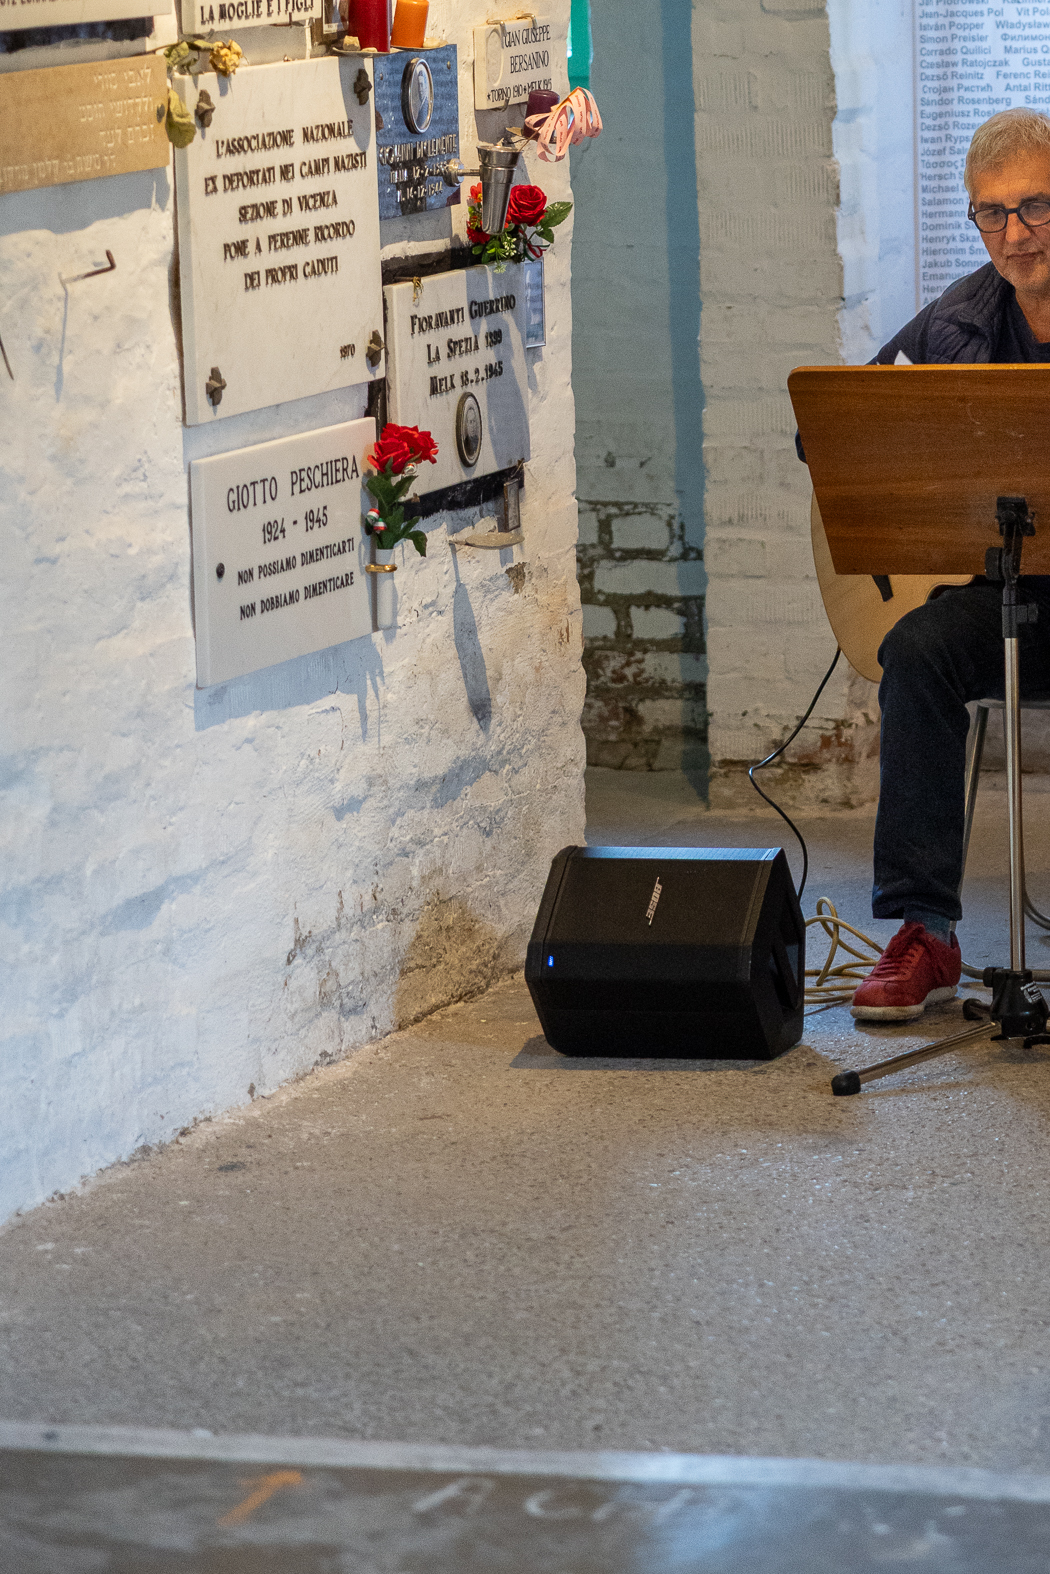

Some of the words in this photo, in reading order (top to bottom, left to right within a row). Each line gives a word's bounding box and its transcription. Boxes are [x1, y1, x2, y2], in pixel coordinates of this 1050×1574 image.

[200, 5, 215, 25] LA
[219, 0, 263, 22] MOGLIE
[522, 25, 551, 45] GIUSEPPE
[510, 50, 550, 74] BERSANINO
[302, 119, 354, 145] NAZIONALE
[204, 174, 218, 196] EX
[223, 166, 276, 193] DEPORTATI
[280, 163, 295, 182] NEI
[300, 156, 331, 178] CAMPI
[333, 151, 368, 173] NAZISTI
[238, 199, 279, 223] SEZIONE
[282, 197, 293, 216] DI
[297, 189, 338, 213] VICENZA
[223, 239, 250, 262] PONE
[254, 237, 263, 255] A
[268, 227, 311, 253] PERENNE
[314, 219, 356, 244] RICORDO
[244, 270, 261, 292] DEI
[265, 263, 298, 287] PROPRI
[303, 256, 339, 279] CADUTI
[227, 476, 278, 513] GIOTTO
[290, 454, 360, 497] PESCHIERA
[262, 517, 286, 544] 1924
[304, 505, 328, 532] 1945
[238, 567, 254, 586] NON
[258, 555, 297, 580] POSSIAMO
[301, 537, 355, 567] DIMENTICARTI
[240, 602, 256, 621] NON
[260, 589, 300, 614] DOBBIAMO
[303, 571, 354, 601] DIMENTICARE
[646, 876, 662, 926] BOSE
